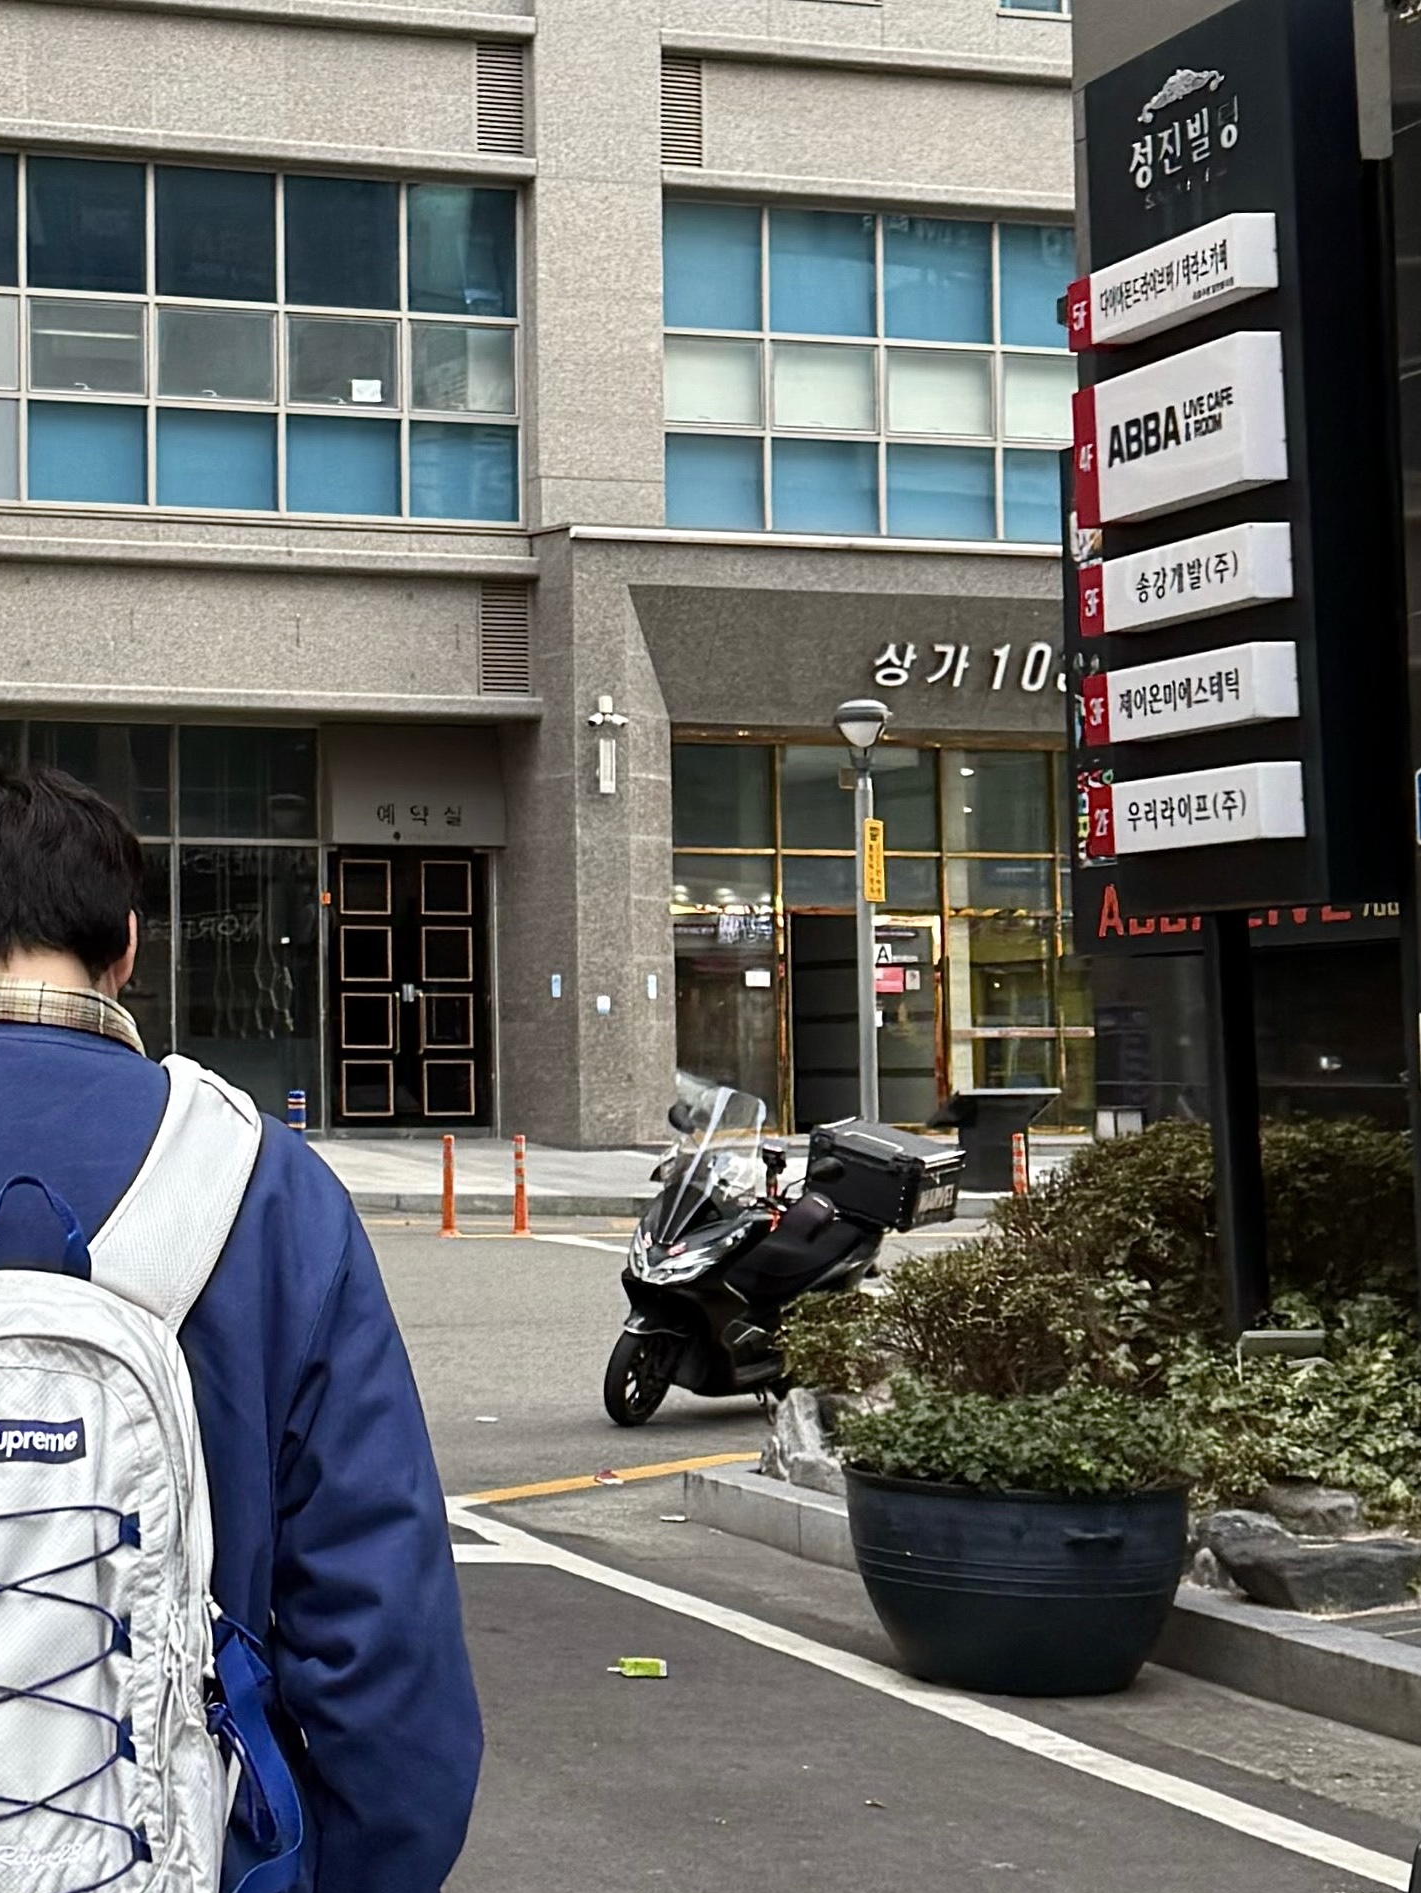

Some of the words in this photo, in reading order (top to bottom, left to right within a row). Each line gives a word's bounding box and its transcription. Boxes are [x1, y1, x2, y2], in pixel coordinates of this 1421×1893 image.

[1072, 300, 1088, 331] 5F
[1183, 395, 1205, 419] LIVE
[1207, 386, 1234, 412] CAFE
[1108, 405, 1182, 469] ABBA
[1193, 413, 1223, 438] ROOM
[1079, 444, 1094, 472] 4F
[1135, 550, 1239, 604] 송강개발(주)
[1084, 588, 1099, 617] 3F
[874, 642, 970, 688] 상가
[992, 640, 1067, 693] 10
[1127, 789, 1247, 832] 우리라이프(주)
